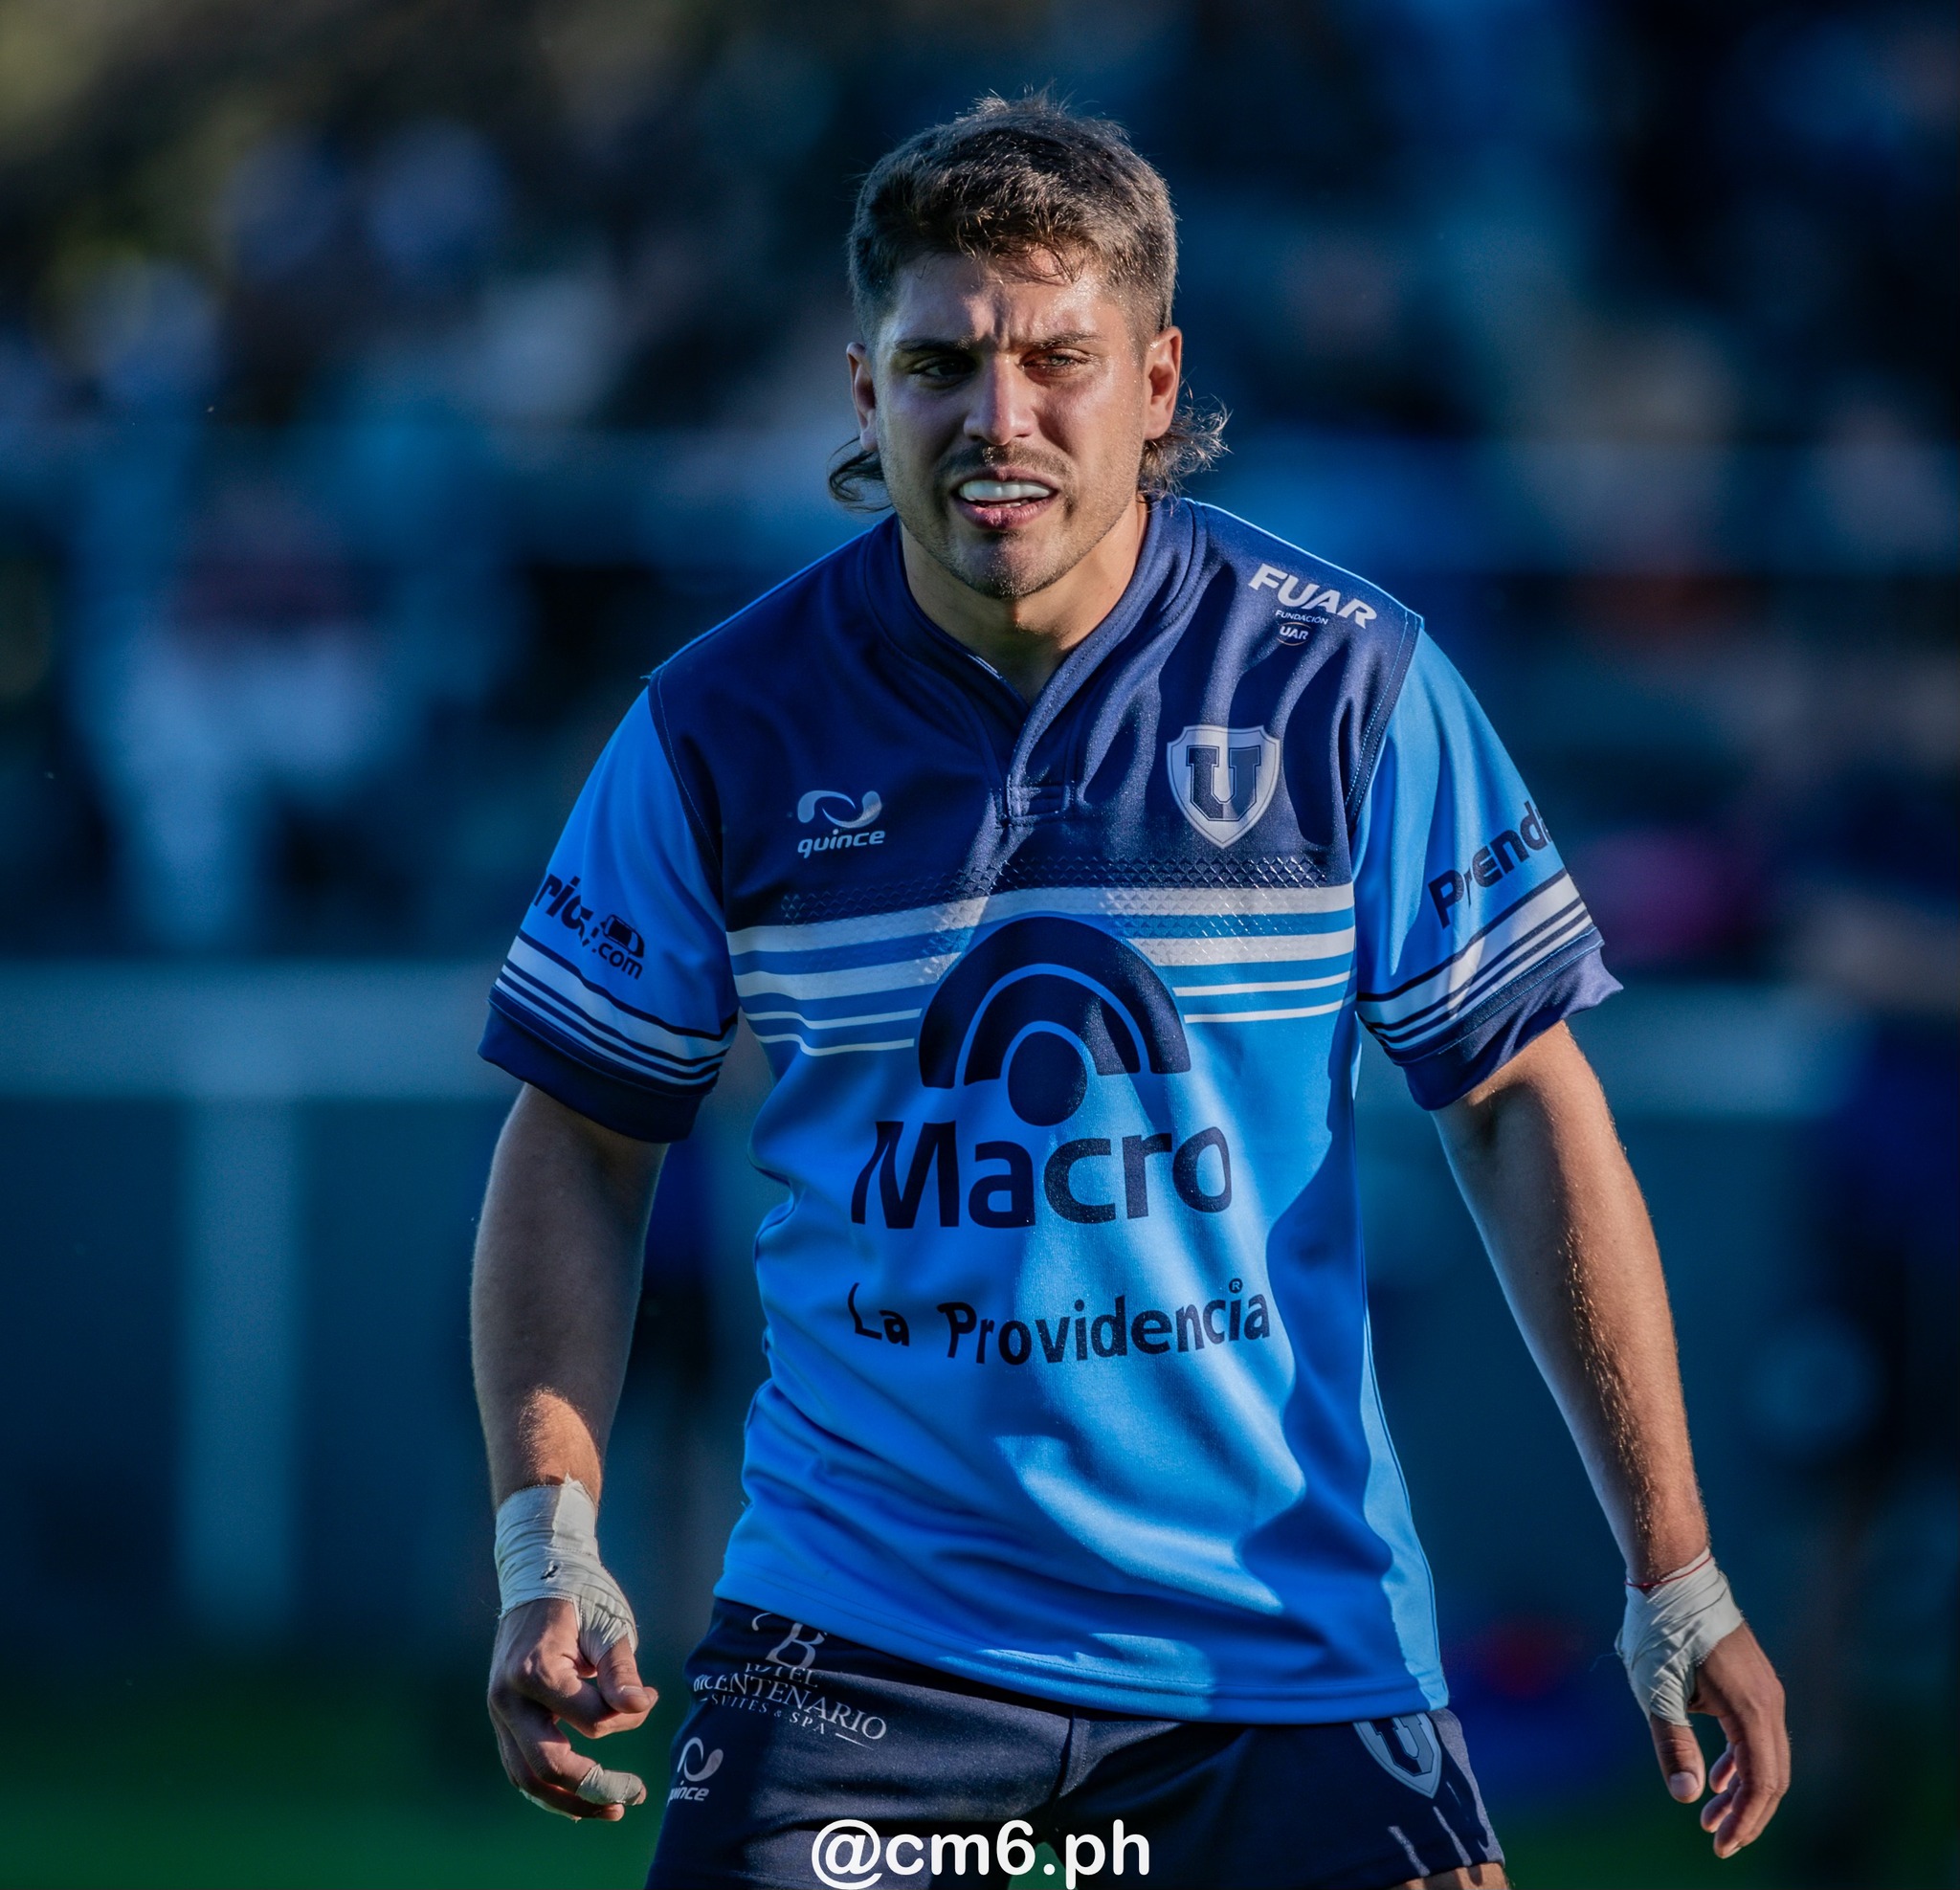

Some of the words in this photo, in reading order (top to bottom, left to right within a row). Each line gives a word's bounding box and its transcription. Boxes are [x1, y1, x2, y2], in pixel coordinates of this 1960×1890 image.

[1248, 563, 1377, 629] FUAR
[1275, 610, 1329, 625] FUNDACIÓN
[1280, 625, 1309, 640] UAR
[1186, 745, 1261, 822] U
[797, 829, 886, 858] quince
[1428, 800, 1552, 930] Prend
[851, 1120, 1233, 1230] Macro
[847, 1282, 910, 1347] La
[936, 1278, 1271, 1367] Providencia
[789, 1711, 825, 1735] SPA
